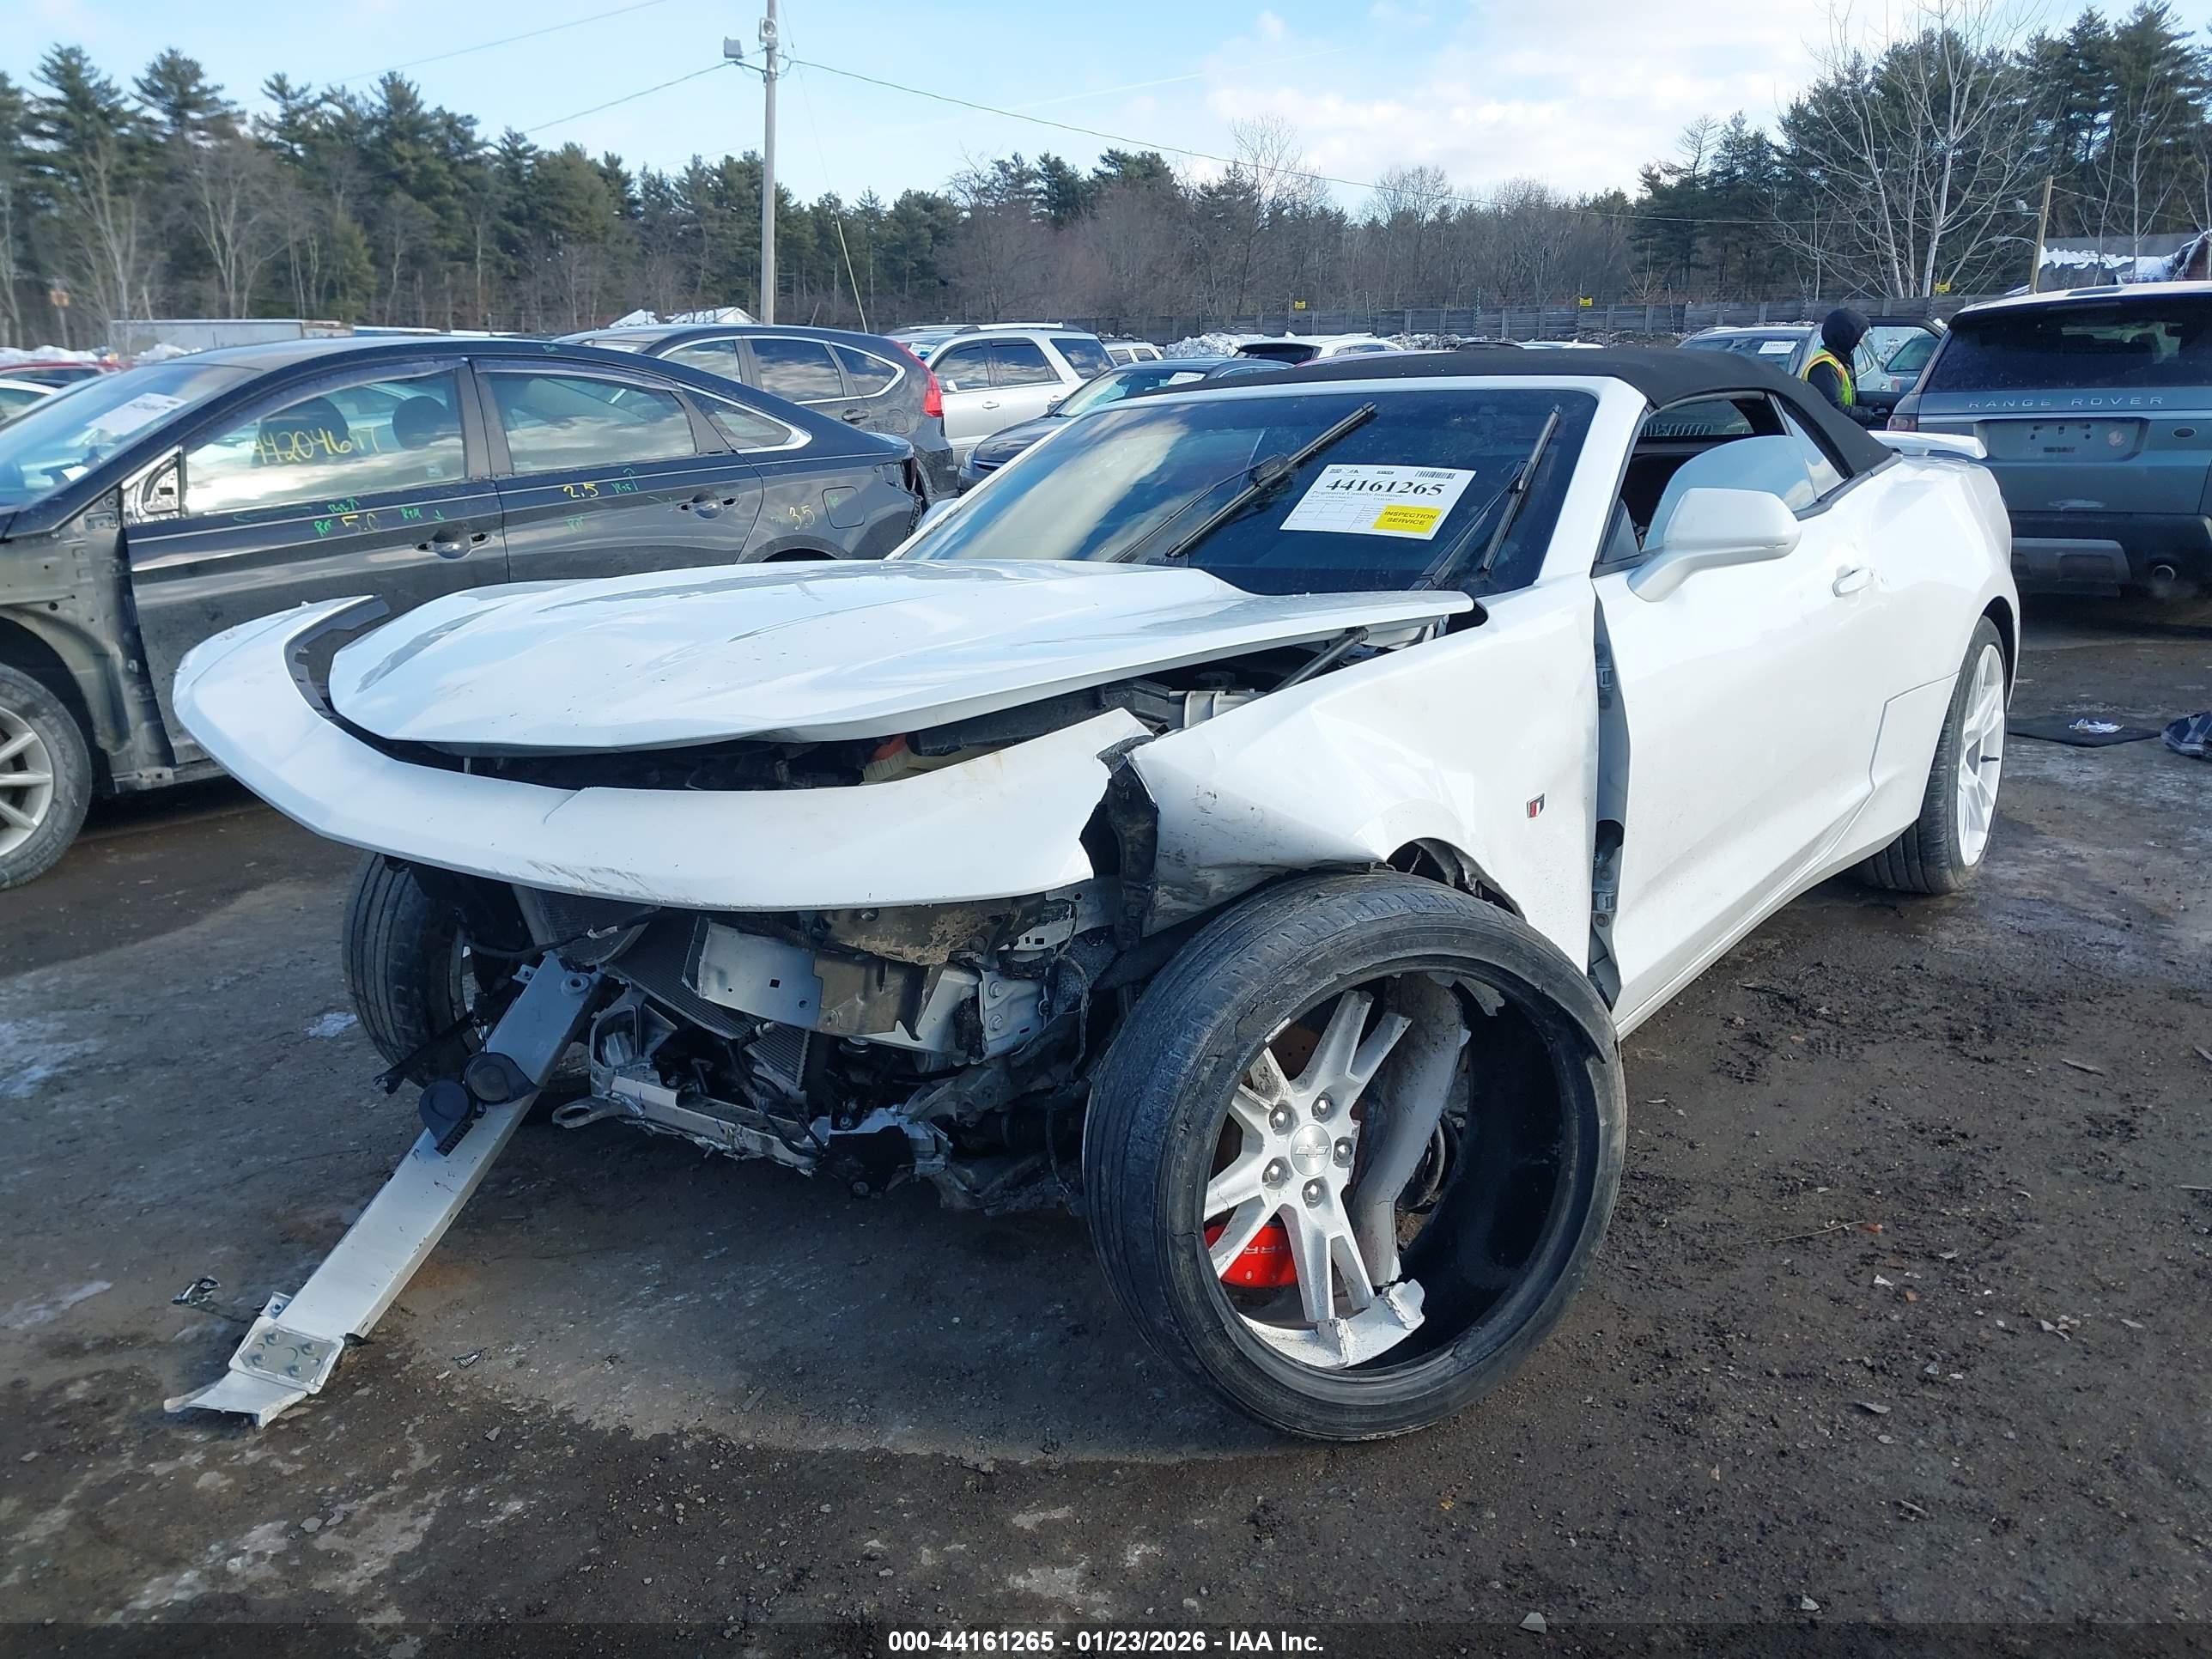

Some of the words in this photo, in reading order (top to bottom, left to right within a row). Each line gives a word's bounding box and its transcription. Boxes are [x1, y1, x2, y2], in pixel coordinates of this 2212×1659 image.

[1968, 398, 2051, 409] RANGE
[2070, 397, 2164, 407] ROVER
[1326, 479, 1446, 496] 44161265
[1383, 510, 1437, 520] INSPECTION
